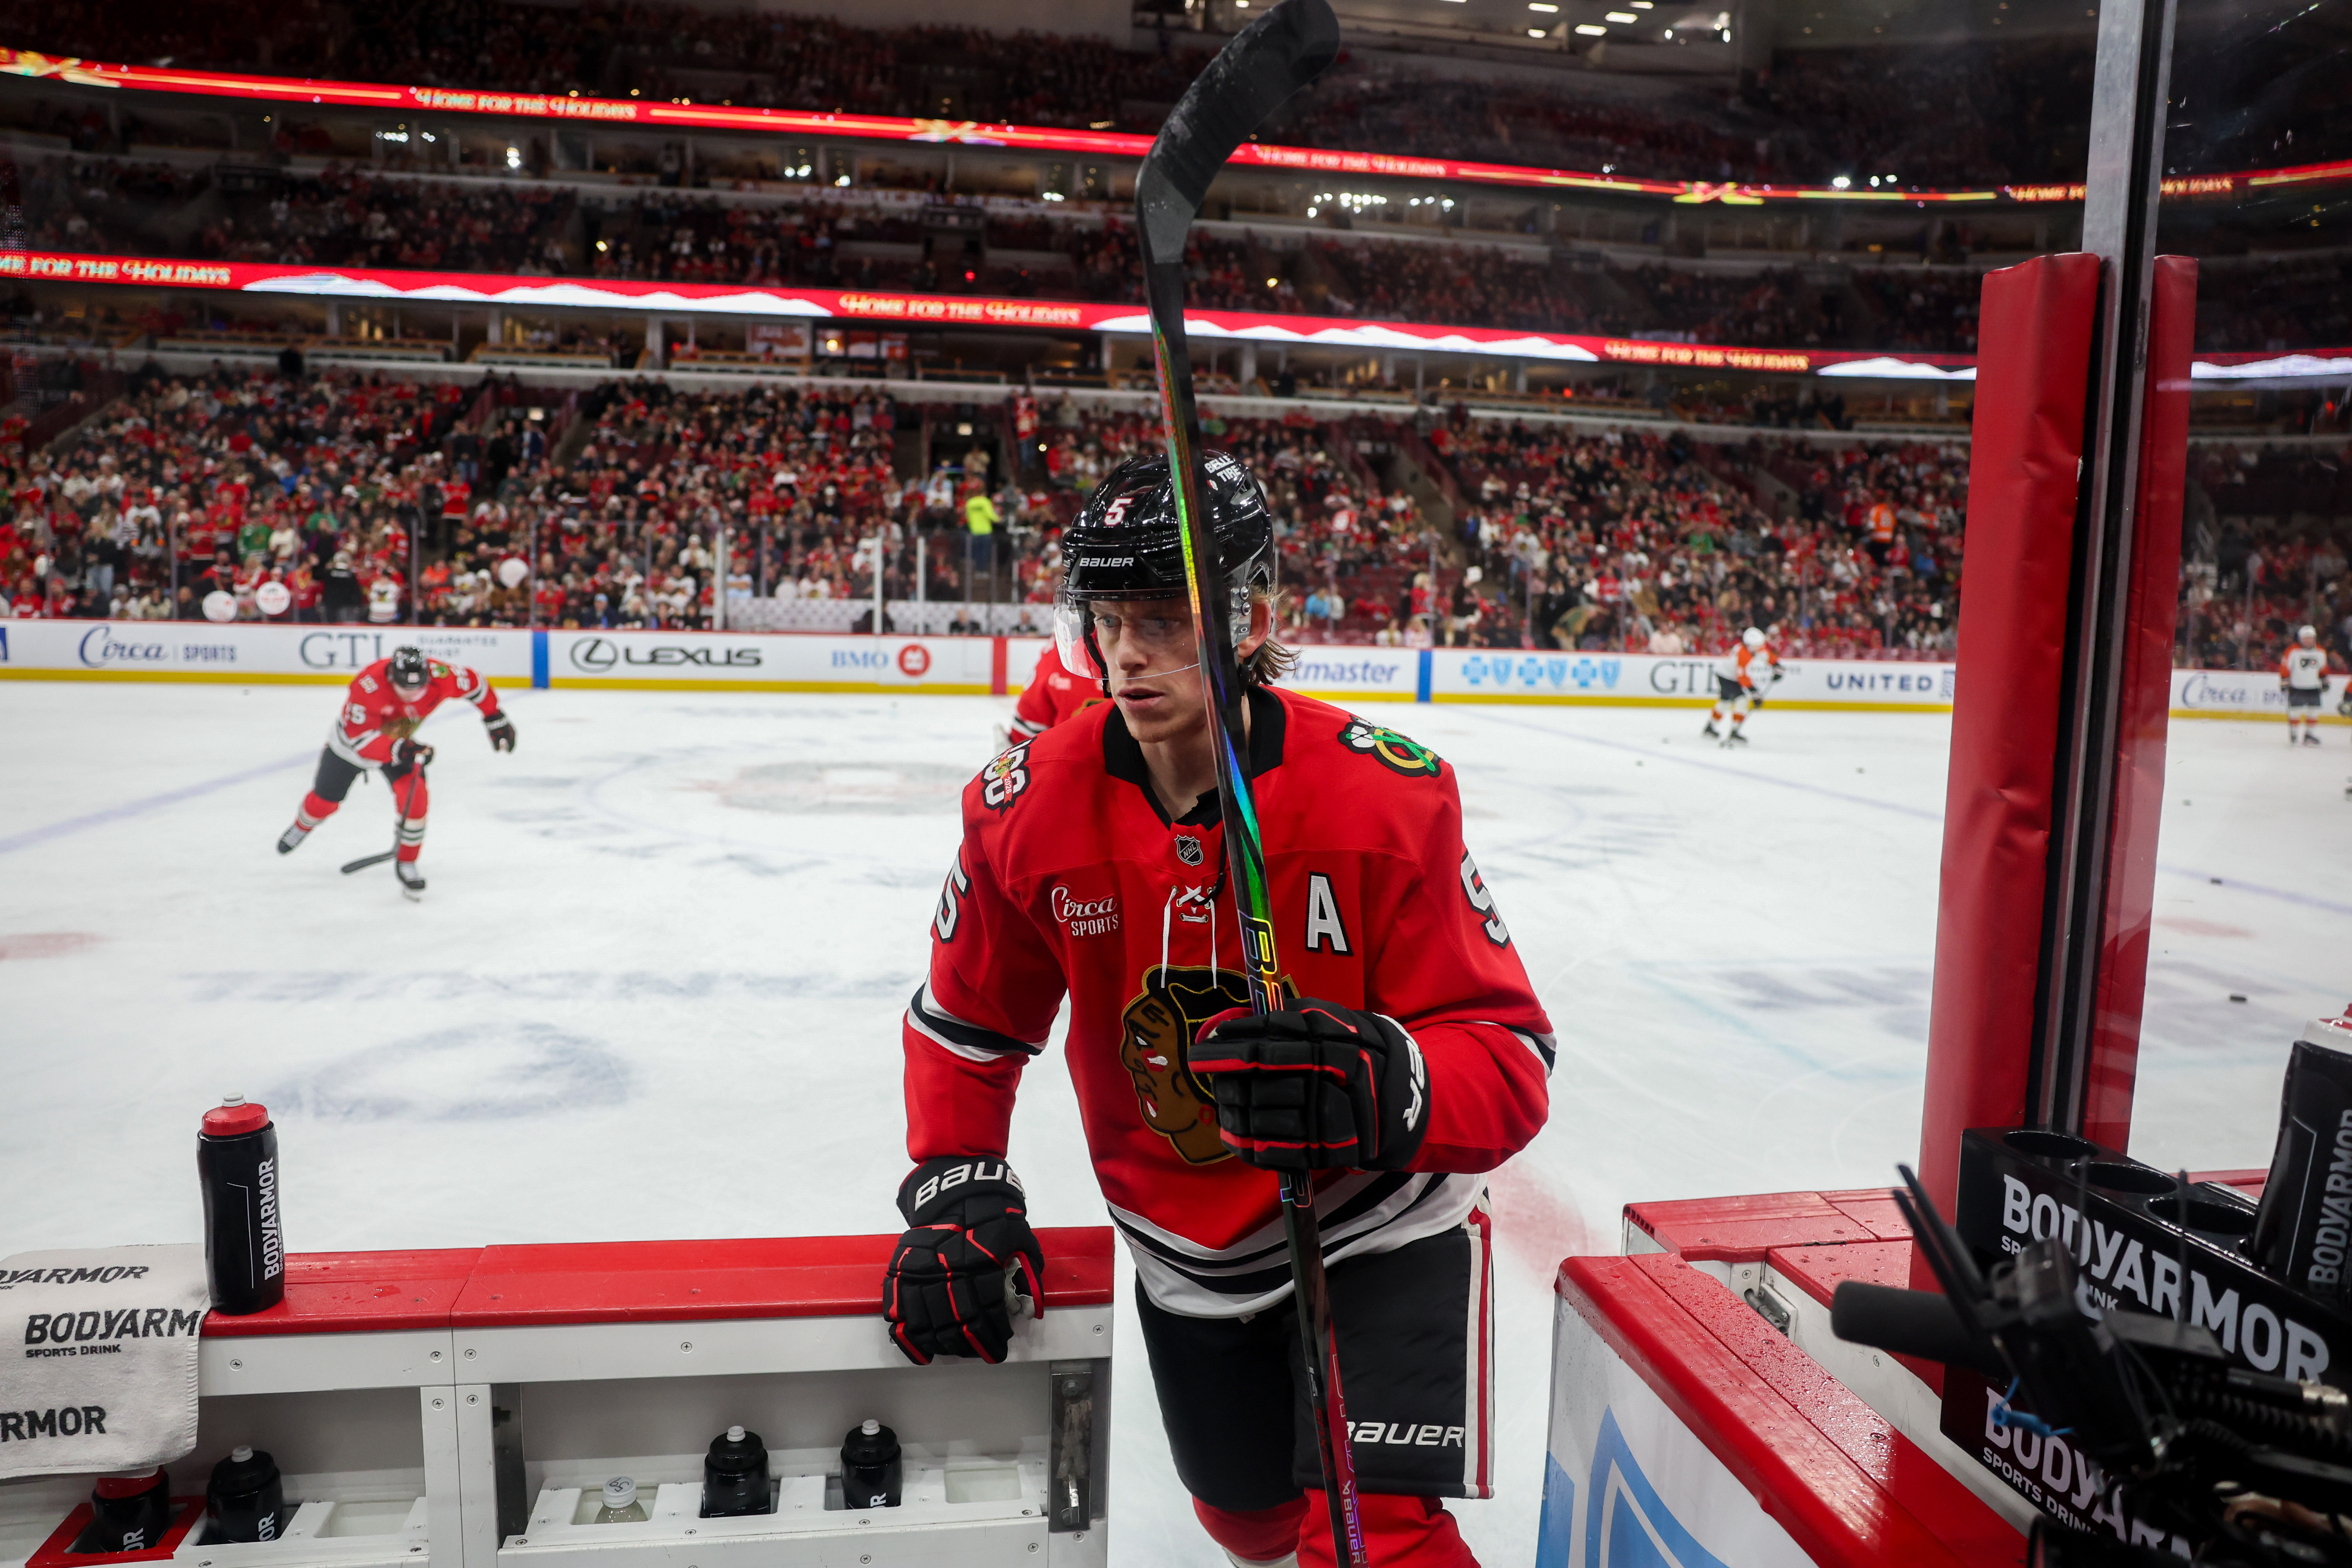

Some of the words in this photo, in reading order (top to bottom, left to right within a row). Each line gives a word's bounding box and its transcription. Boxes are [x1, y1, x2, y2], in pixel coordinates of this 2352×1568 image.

[30, 257, 73, 276] FOR
[75, 260, 118, 279] THE
[121, 260, 230, 286] HOLIDAYS
[839, 294, 906, 316] HOME
[908, 301, 945, 318] FOR
[946, 302, 983, 319] THE
[985, 302, 1082, 323] HOLIDAYS
[1204, 456, 1234, 474] BELLE
[1216, 465, 1241, 482] TIRE
[1103, 498, 1134, 526] 5
[79, 623, 169, 668] Circa
[183, 644, 237, 662] SPORTS
[625, 646, 762, 667] LEXUS
[831, 650, 889, 668] BMO
[1827, 673, 1933, 691] UNITED
[1004, 777, 1012, 794] 2026
[1183, 843, 1197, 858] NHL
[934, 847, 970, 943] 5
[1051, 887, 1117, 923] Circa
[1461, 848, 1510, 949] 5
[1071, 914, 1118, 936] SPORTS
[1306, 873, 1352, 955] A
[258, 1156, 280, 1281] BODYARMOR
[26, 1347, 76, 1358] SPORTS
[80, 1344, 122, 1355] DRINK
[1983, 1446, 2042, 1503] SPORTS
